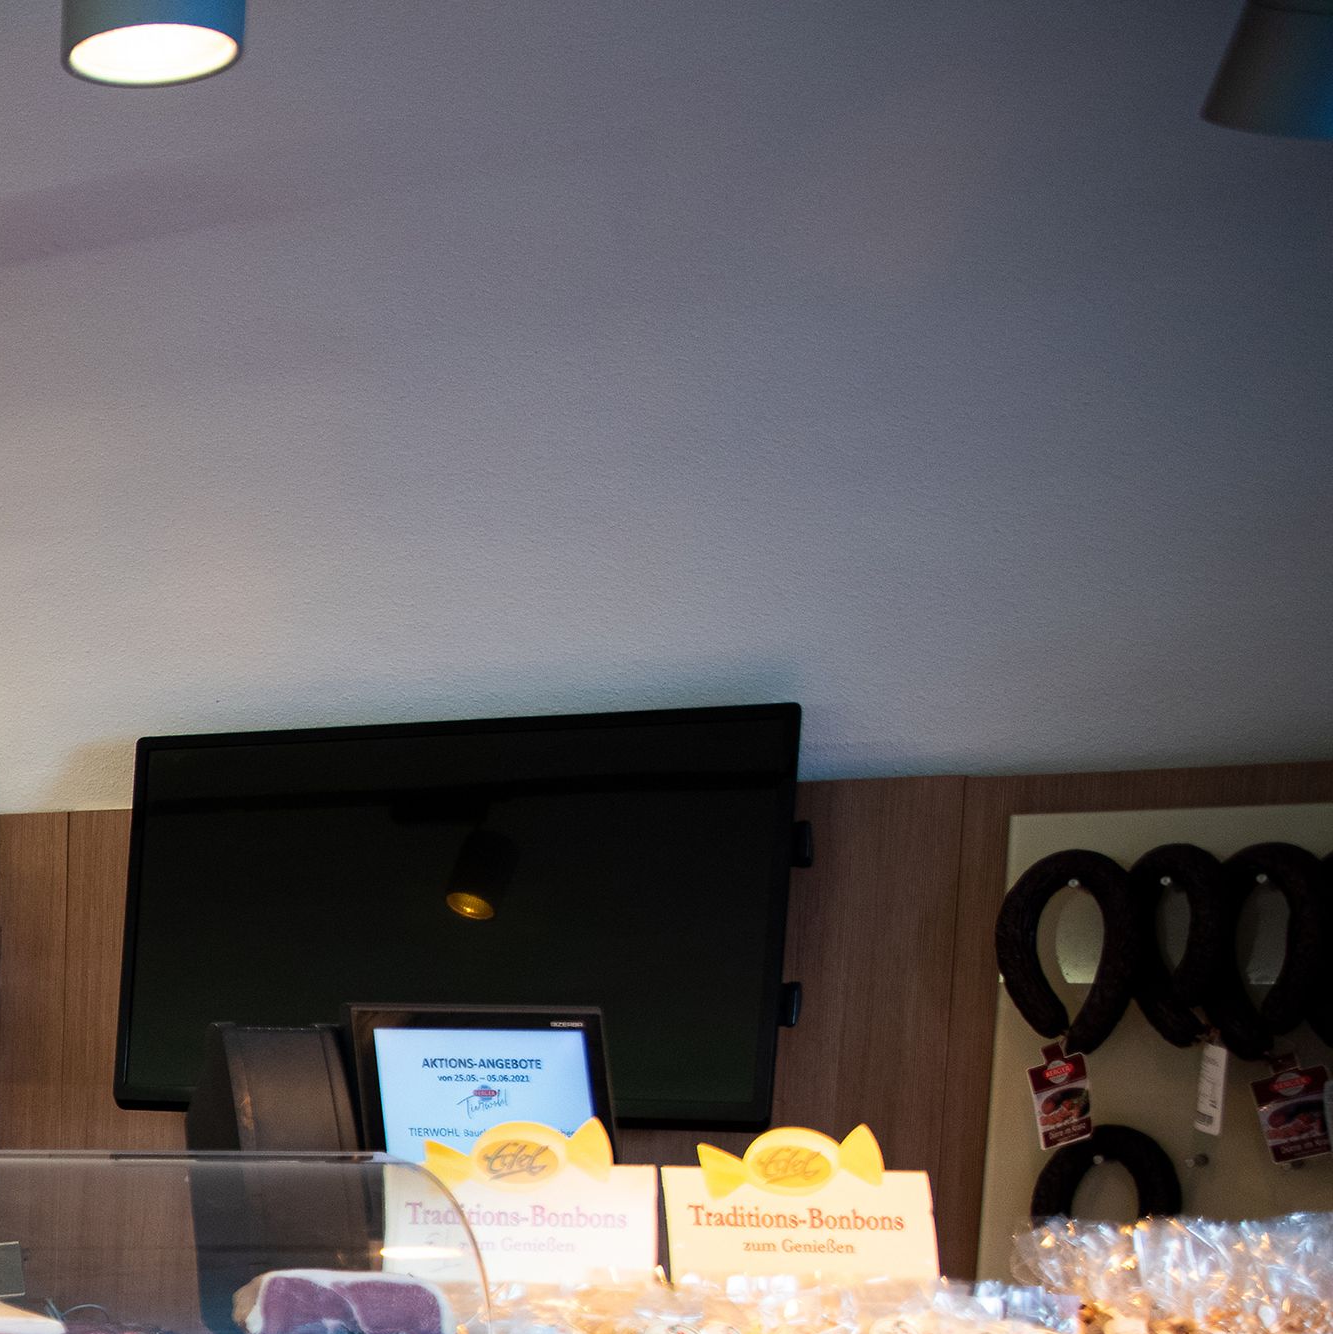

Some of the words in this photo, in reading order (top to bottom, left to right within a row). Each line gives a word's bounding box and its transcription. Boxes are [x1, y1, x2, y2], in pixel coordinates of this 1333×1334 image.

[421, 1057, 542, 1070] AKTIONS-ANGEBOTE
[454, 1074, 479, 1082] 25.05.
[486, 1074, 530, 1083] 05.06.2021
[408, 1127, 460, 1138] TIERWOHL
[405, 1200, 628, 1230] Traditions-Bonbons
[687, 1204, 905, 1233] Traditions-Bonbons
[501, 1236, 576, 1255] Genießen
[742, 1241, 777, 1255] zum
[781, 1237, 856, 1256] Genießen
